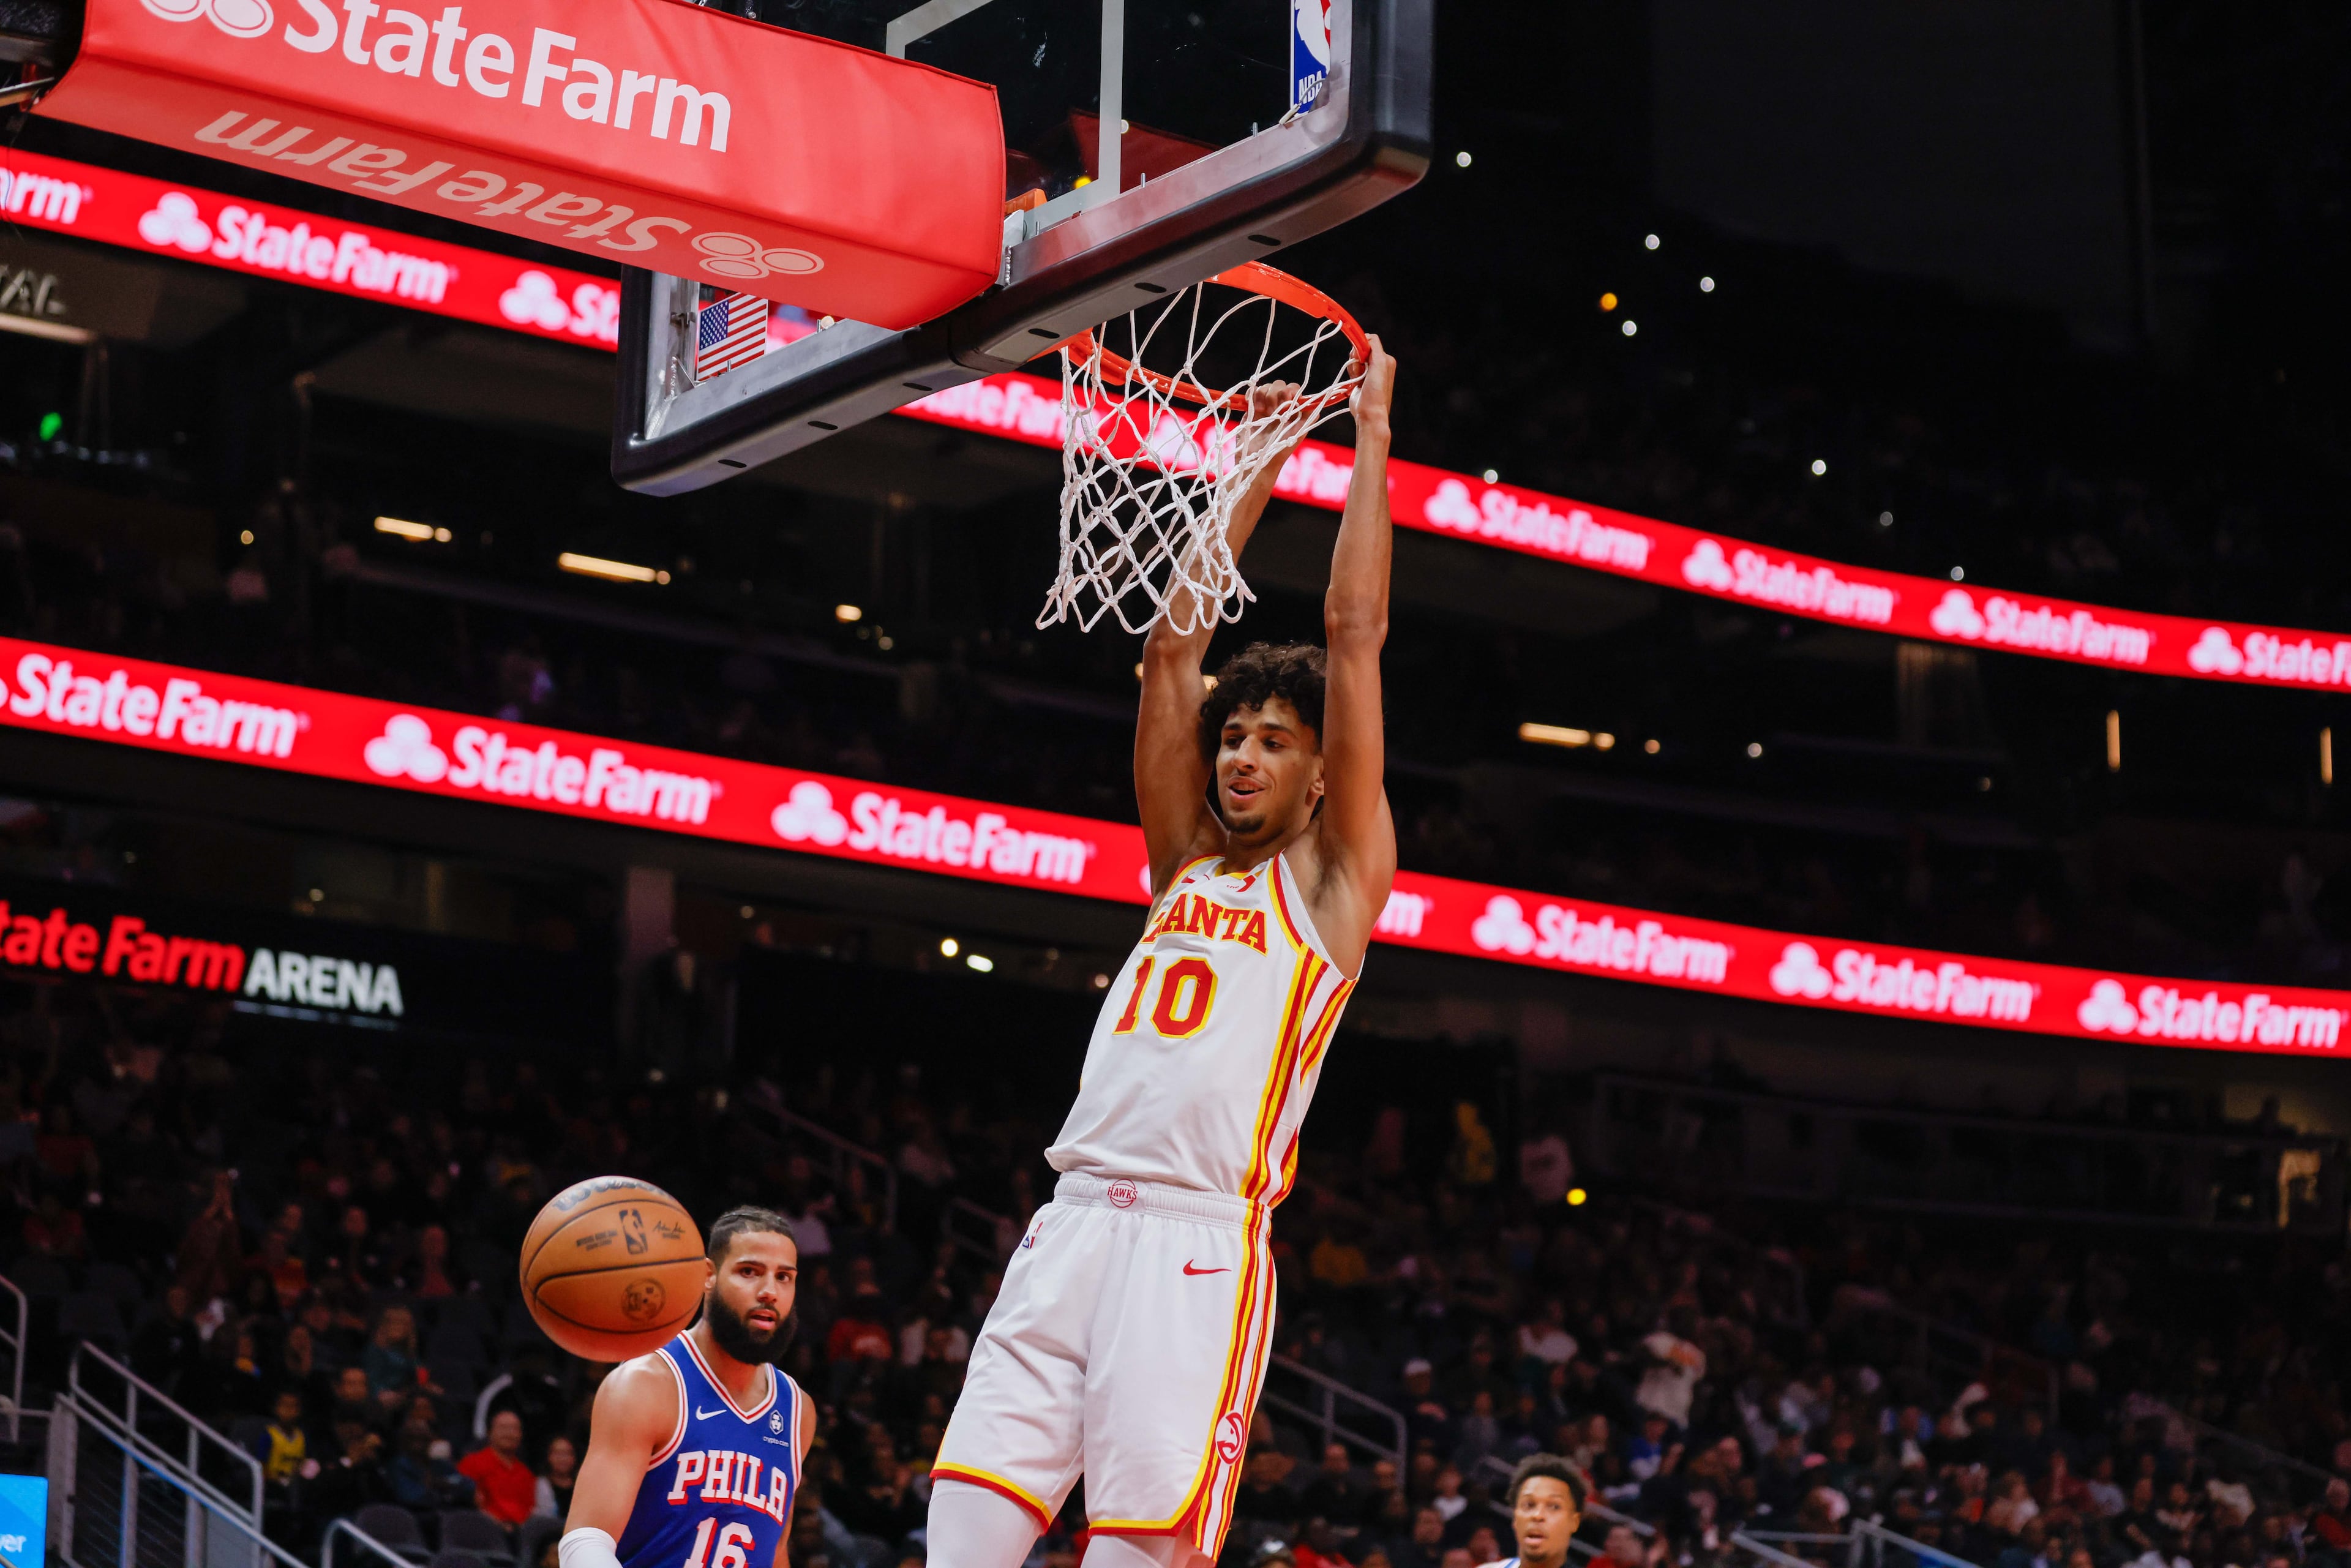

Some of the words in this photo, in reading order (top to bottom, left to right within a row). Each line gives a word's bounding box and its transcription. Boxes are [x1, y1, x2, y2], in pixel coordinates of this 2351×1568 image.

[1299, 70, 1322, 104] NBA
[2243, 632, 2351, 686] StateF
[244, 948, 403, 1016] ARENA
[1112, 955, 1218, 1039] 10
[1107, 1187, 1138, 1200] HAWKS
[667, 1450, 788, 1526] PHILA
[683, 1517, 756, 1568] 16
